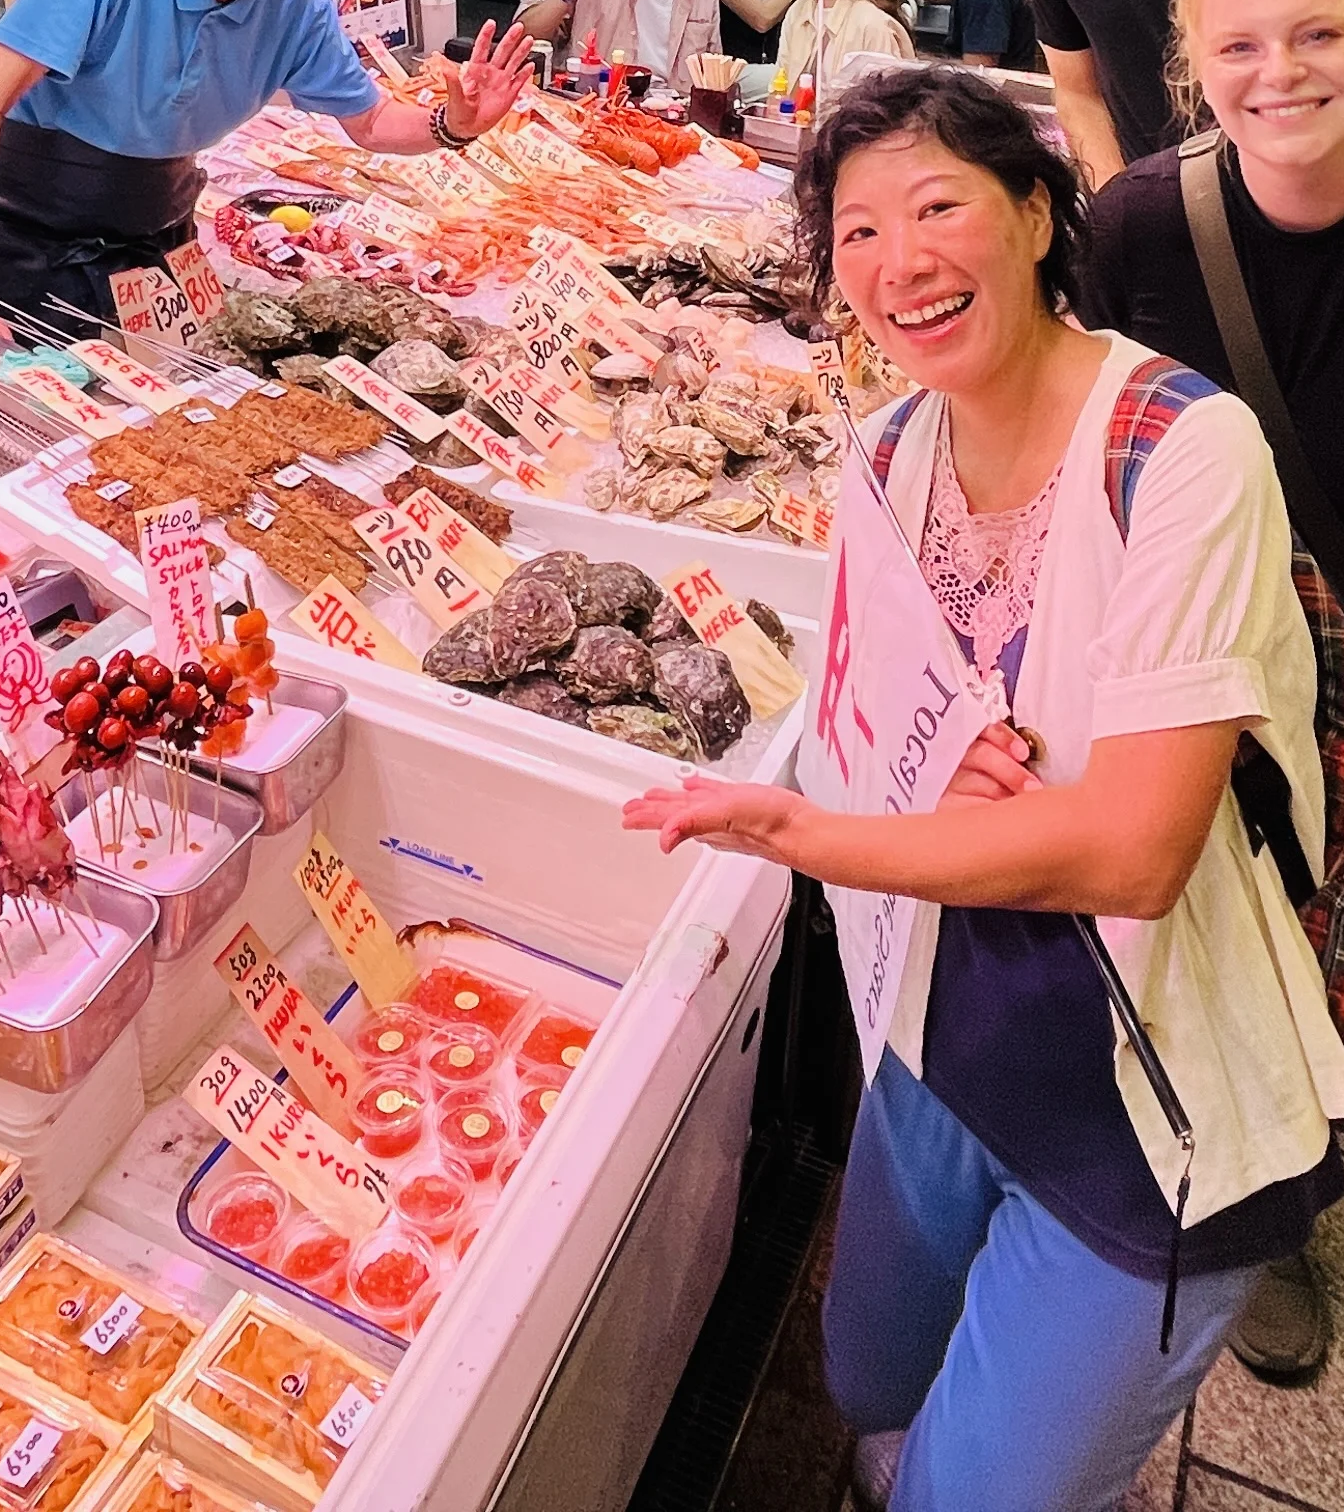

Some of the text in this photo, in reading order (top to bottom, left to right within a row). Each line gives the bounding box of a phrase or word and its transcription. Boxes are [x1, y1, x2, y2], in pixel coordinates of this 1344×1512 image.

[170, 243, 205, 278] SUPER
[117, 279, 147, 307] EAT
[184, 266, 225, 316] BIG
[123, 310, 154, 333] HERE
[151, 291, 189, 333] 1300
[529, 332, 564, 371] 800
[509, 366, 541, 392] EAT
[492, 387, 525, 422] 750
[143, 509, 193, 545] ¥400
[405, 492, 444, 533] EAT
[780, 491, 809, 532] EAT
[148, 536, 206, 568] SALMON
[385, 537, 433, 587] 950
[433, 565, 467, 600] 円
[673, 567, 725, 619] EAT
[700, 601, 747, 647] HERE
[406, 841, 433, 858] LOAD
[228, 941, 258, 982] 50g
[263, 987, 304, 1046] IKURA
[199, 1056, 242, 1092] 30g
[226, 1078, 268, 1134] 1400
[259, 1100, 307, 1162] IKURA
[296, 1132, 360, 1189] いくら
[93, 1305, 131, 1346] 6500
[330, 1396, 365, 1439] 6500
[3, 1429, 45, 1478] 6500
